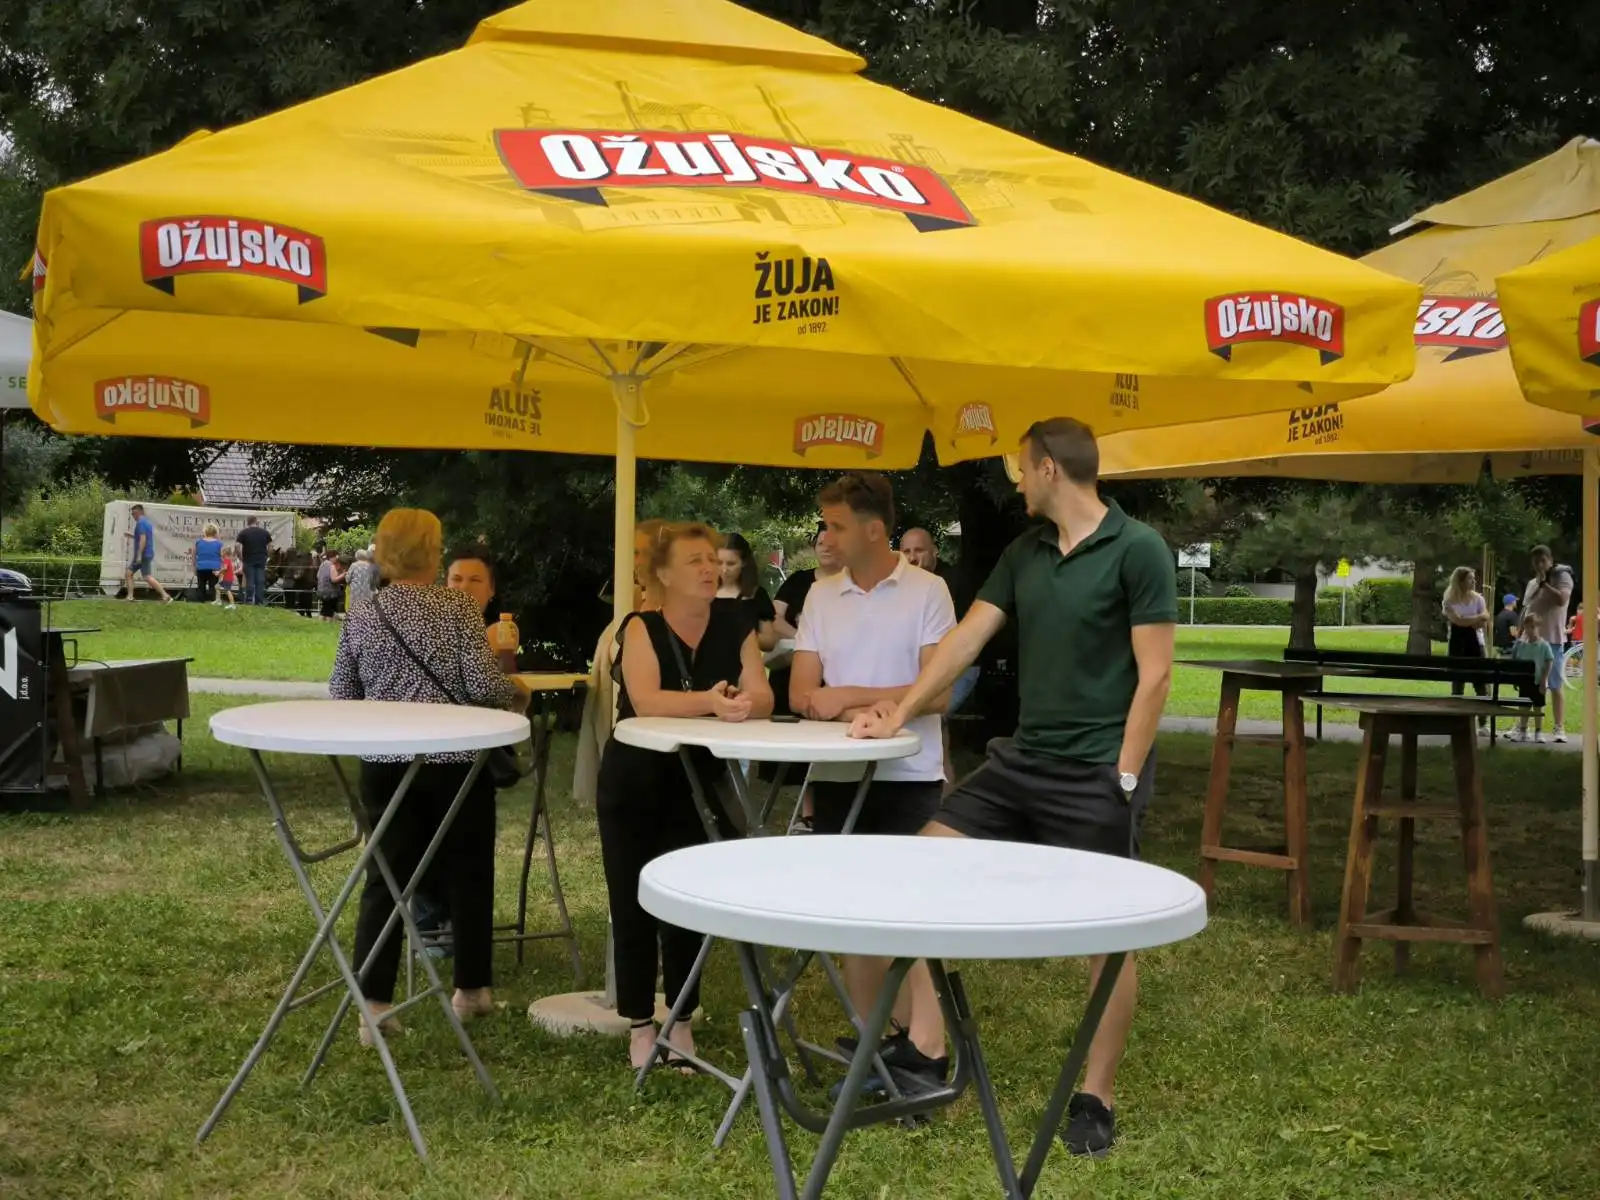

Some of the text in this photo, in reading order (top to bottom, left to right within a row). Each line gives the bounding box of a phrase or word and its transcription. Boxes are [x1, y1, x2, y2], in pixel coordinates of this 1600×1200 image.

[539, 134, 927, 205] Ožujsko
[157, 220, 312, 276] Ožujsko
[754, 251, 835, 299] ŽUJA
[752, 296, 839, 324] JE ZAKON!
[1217, 295, 1333, 341] Ožujsko
[1287, 427, 1299, 443] JE
[1302, 413, 1344, 439] ZAKON!
